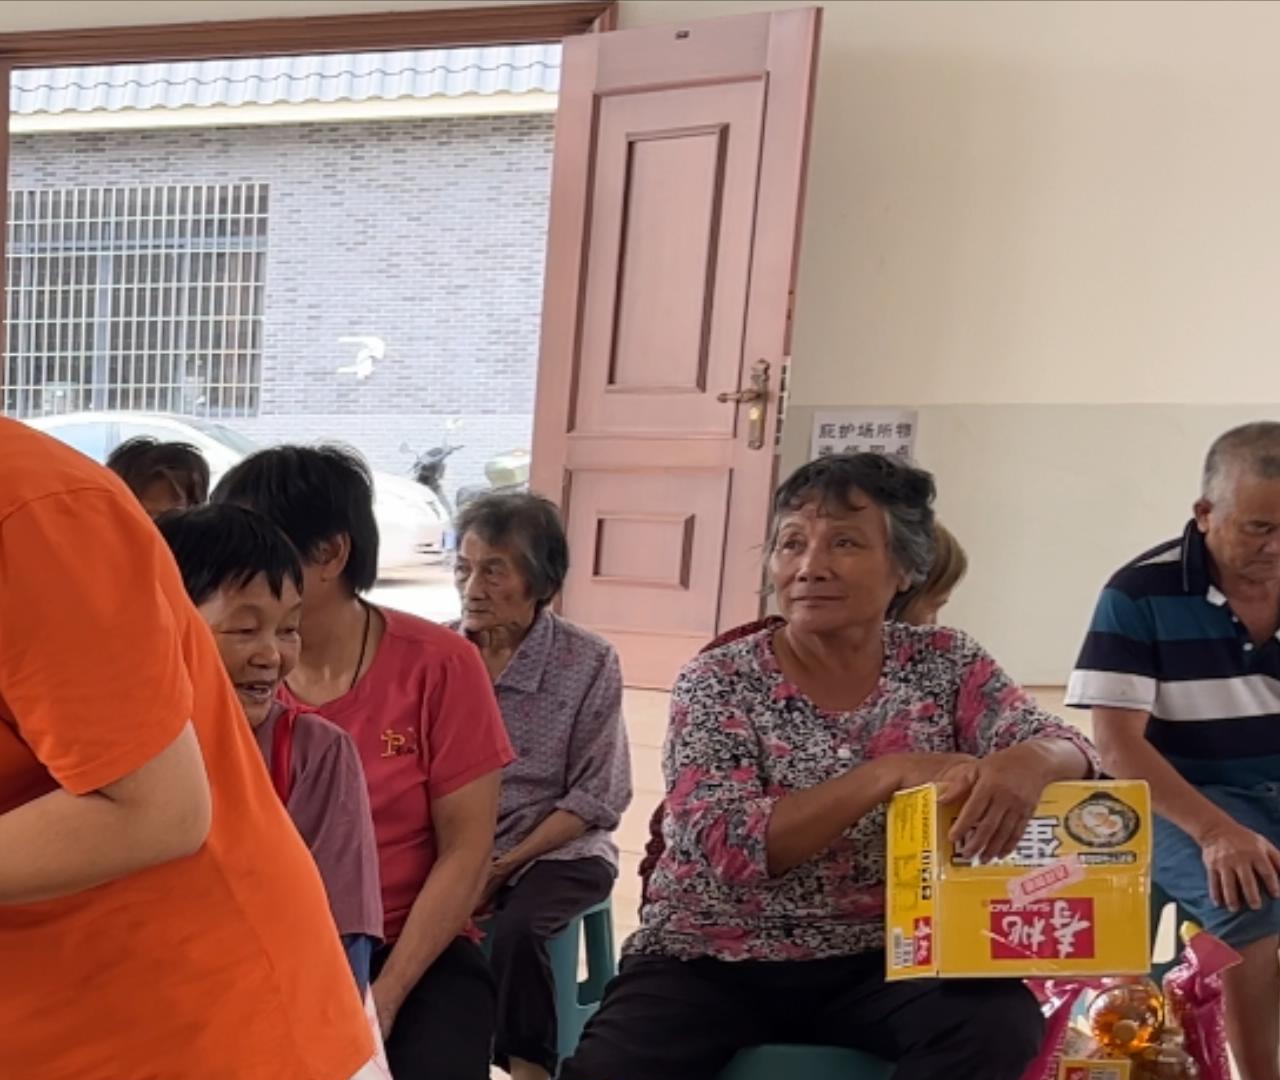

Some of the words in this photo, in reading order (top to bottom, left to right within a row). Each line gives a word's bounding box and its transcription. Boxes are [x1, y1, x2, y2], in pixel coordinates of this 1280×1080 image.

[818, 421, 912, 439] 庇护场所物
[1000, 900, 1092, 959] 寿桃
